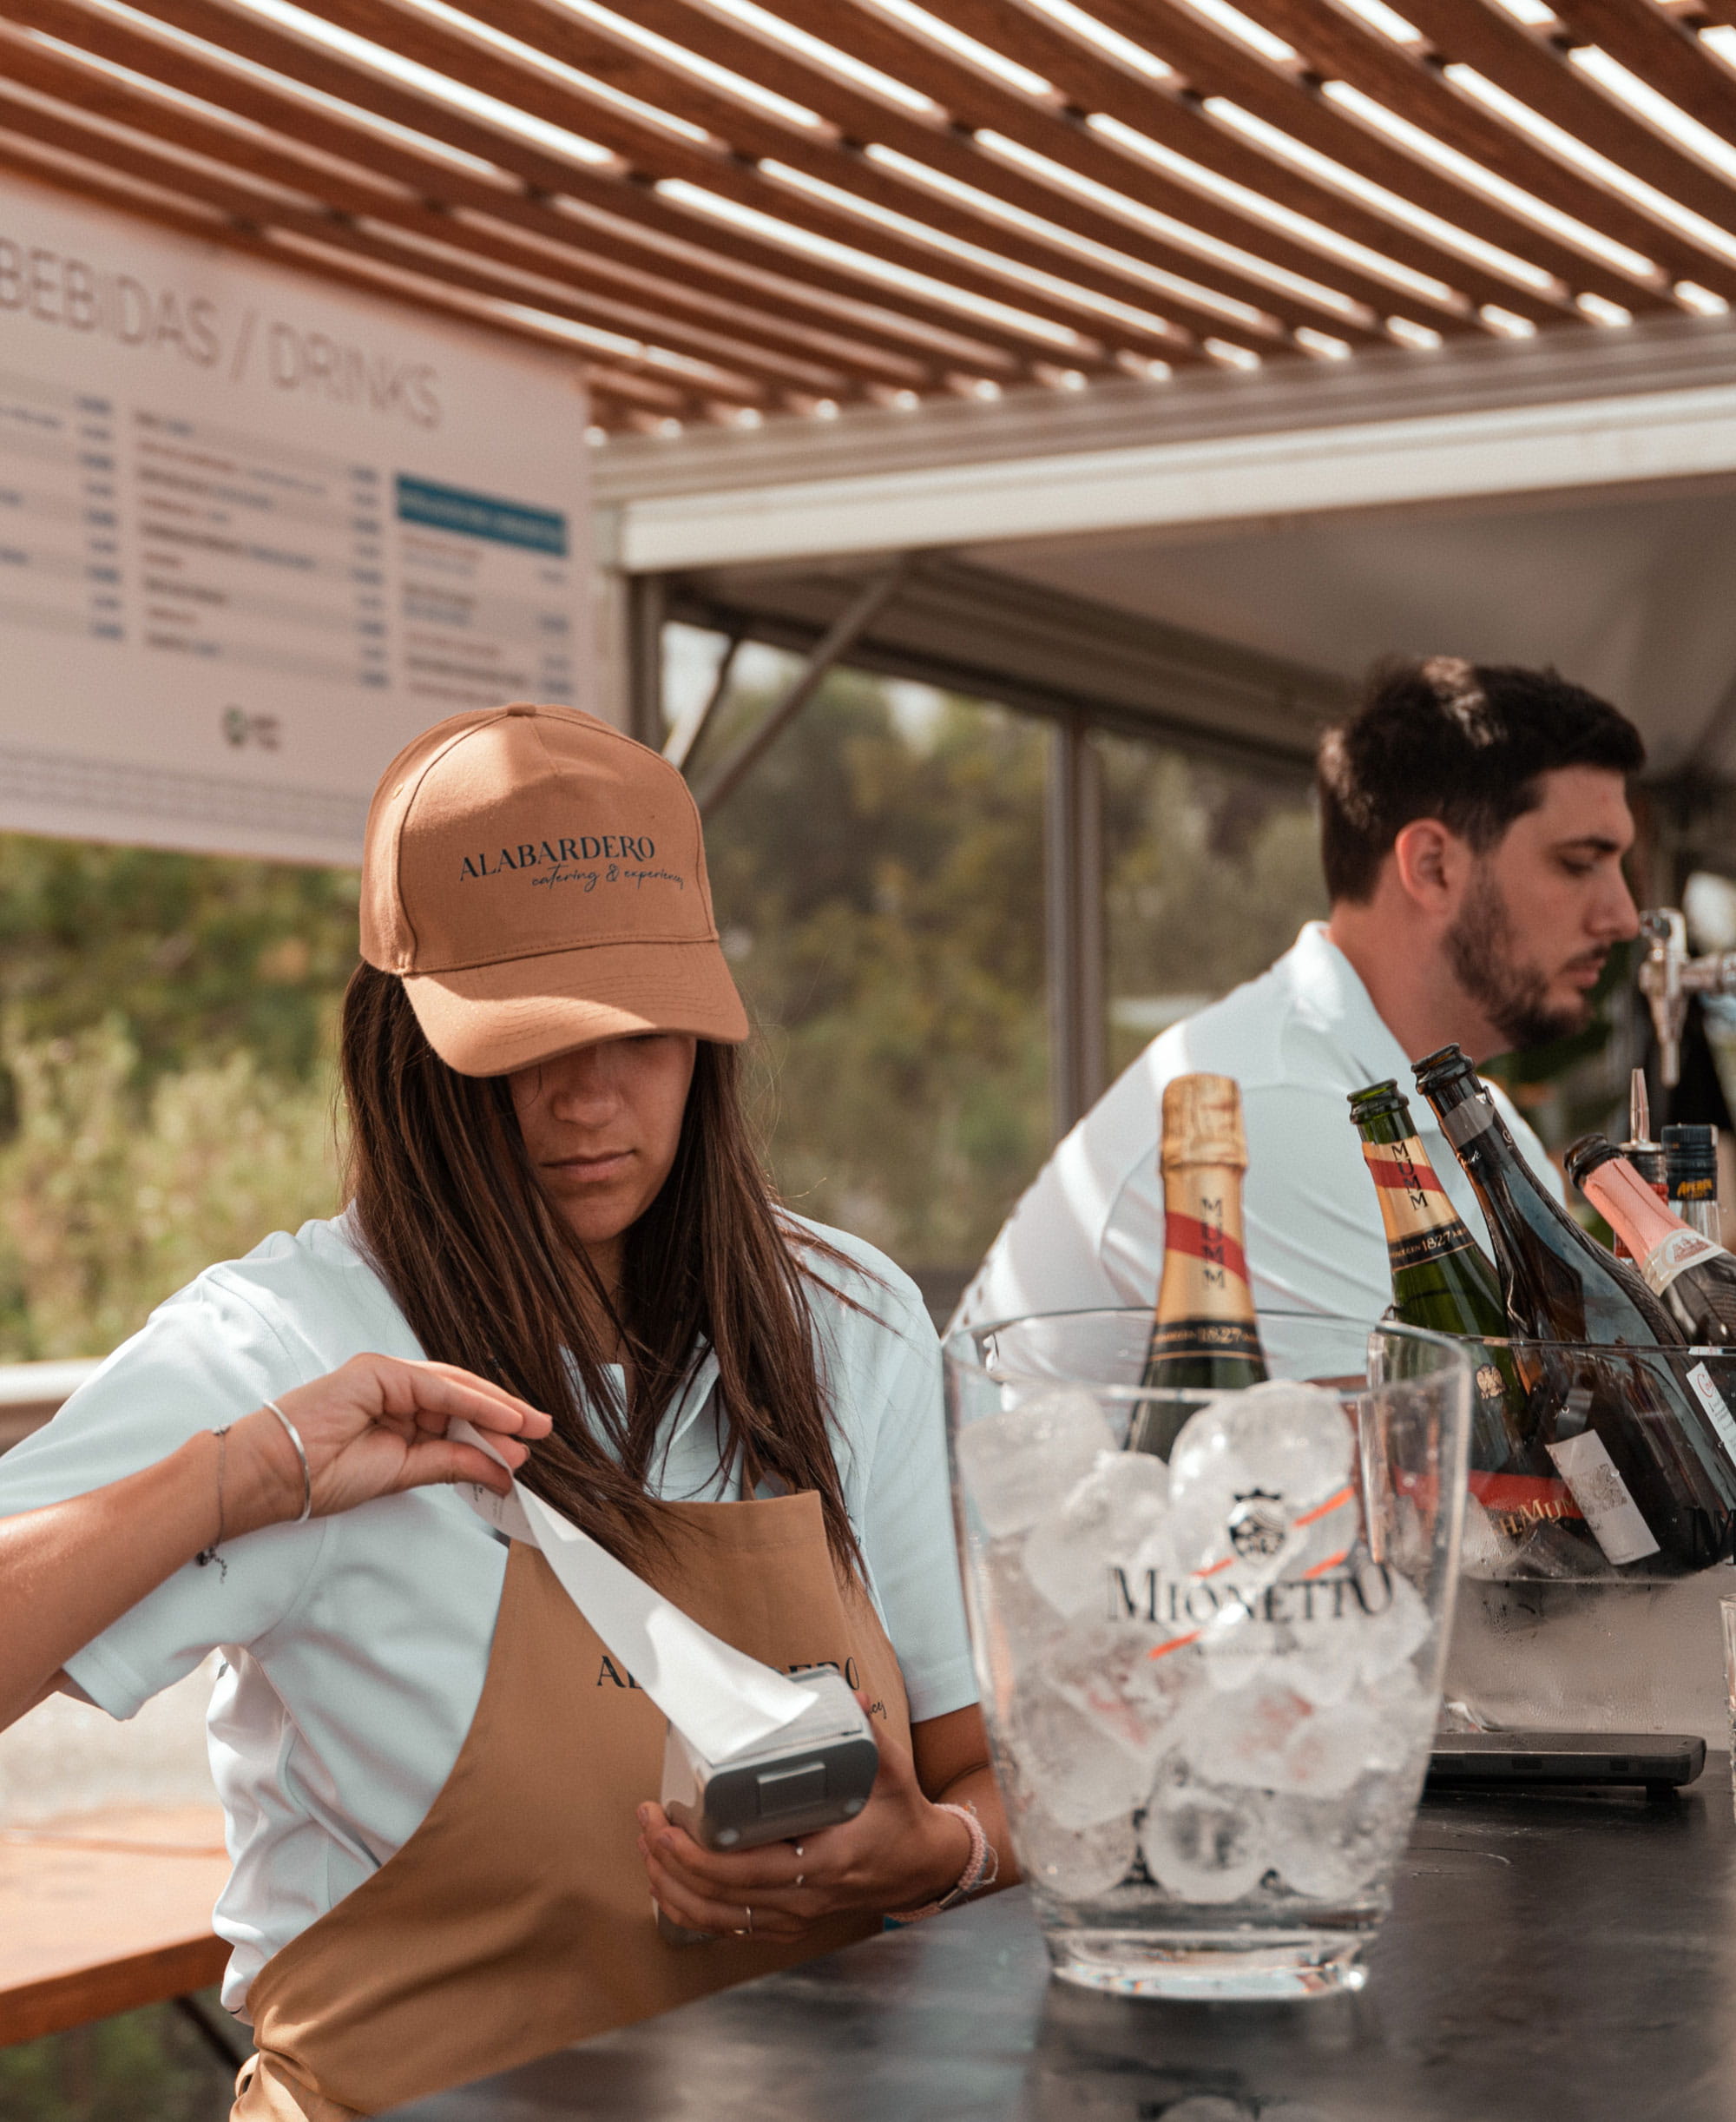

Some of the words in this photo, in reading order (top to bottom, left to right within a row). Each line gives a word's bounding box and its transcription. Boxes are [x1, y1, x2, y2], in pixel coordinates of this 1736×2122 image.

[0, 235, 222, 369] BEBIDAS
[268, 319, 442, 431] DRINKS
[460, 834, 656, 882] ALABARDERO
[531, 863, 600, 893] catering
[605, 862, 621, 883] &
[1391, 1140, 1430, 1212] MUMM
[1199, 1196, 1227, 1291] MUMM
[1421, 1229, 1451, 1253] 1827
[1196, 1325, 1243, 1344] 1827
[1106, 1562, 1395, 1623] MIONETTO
